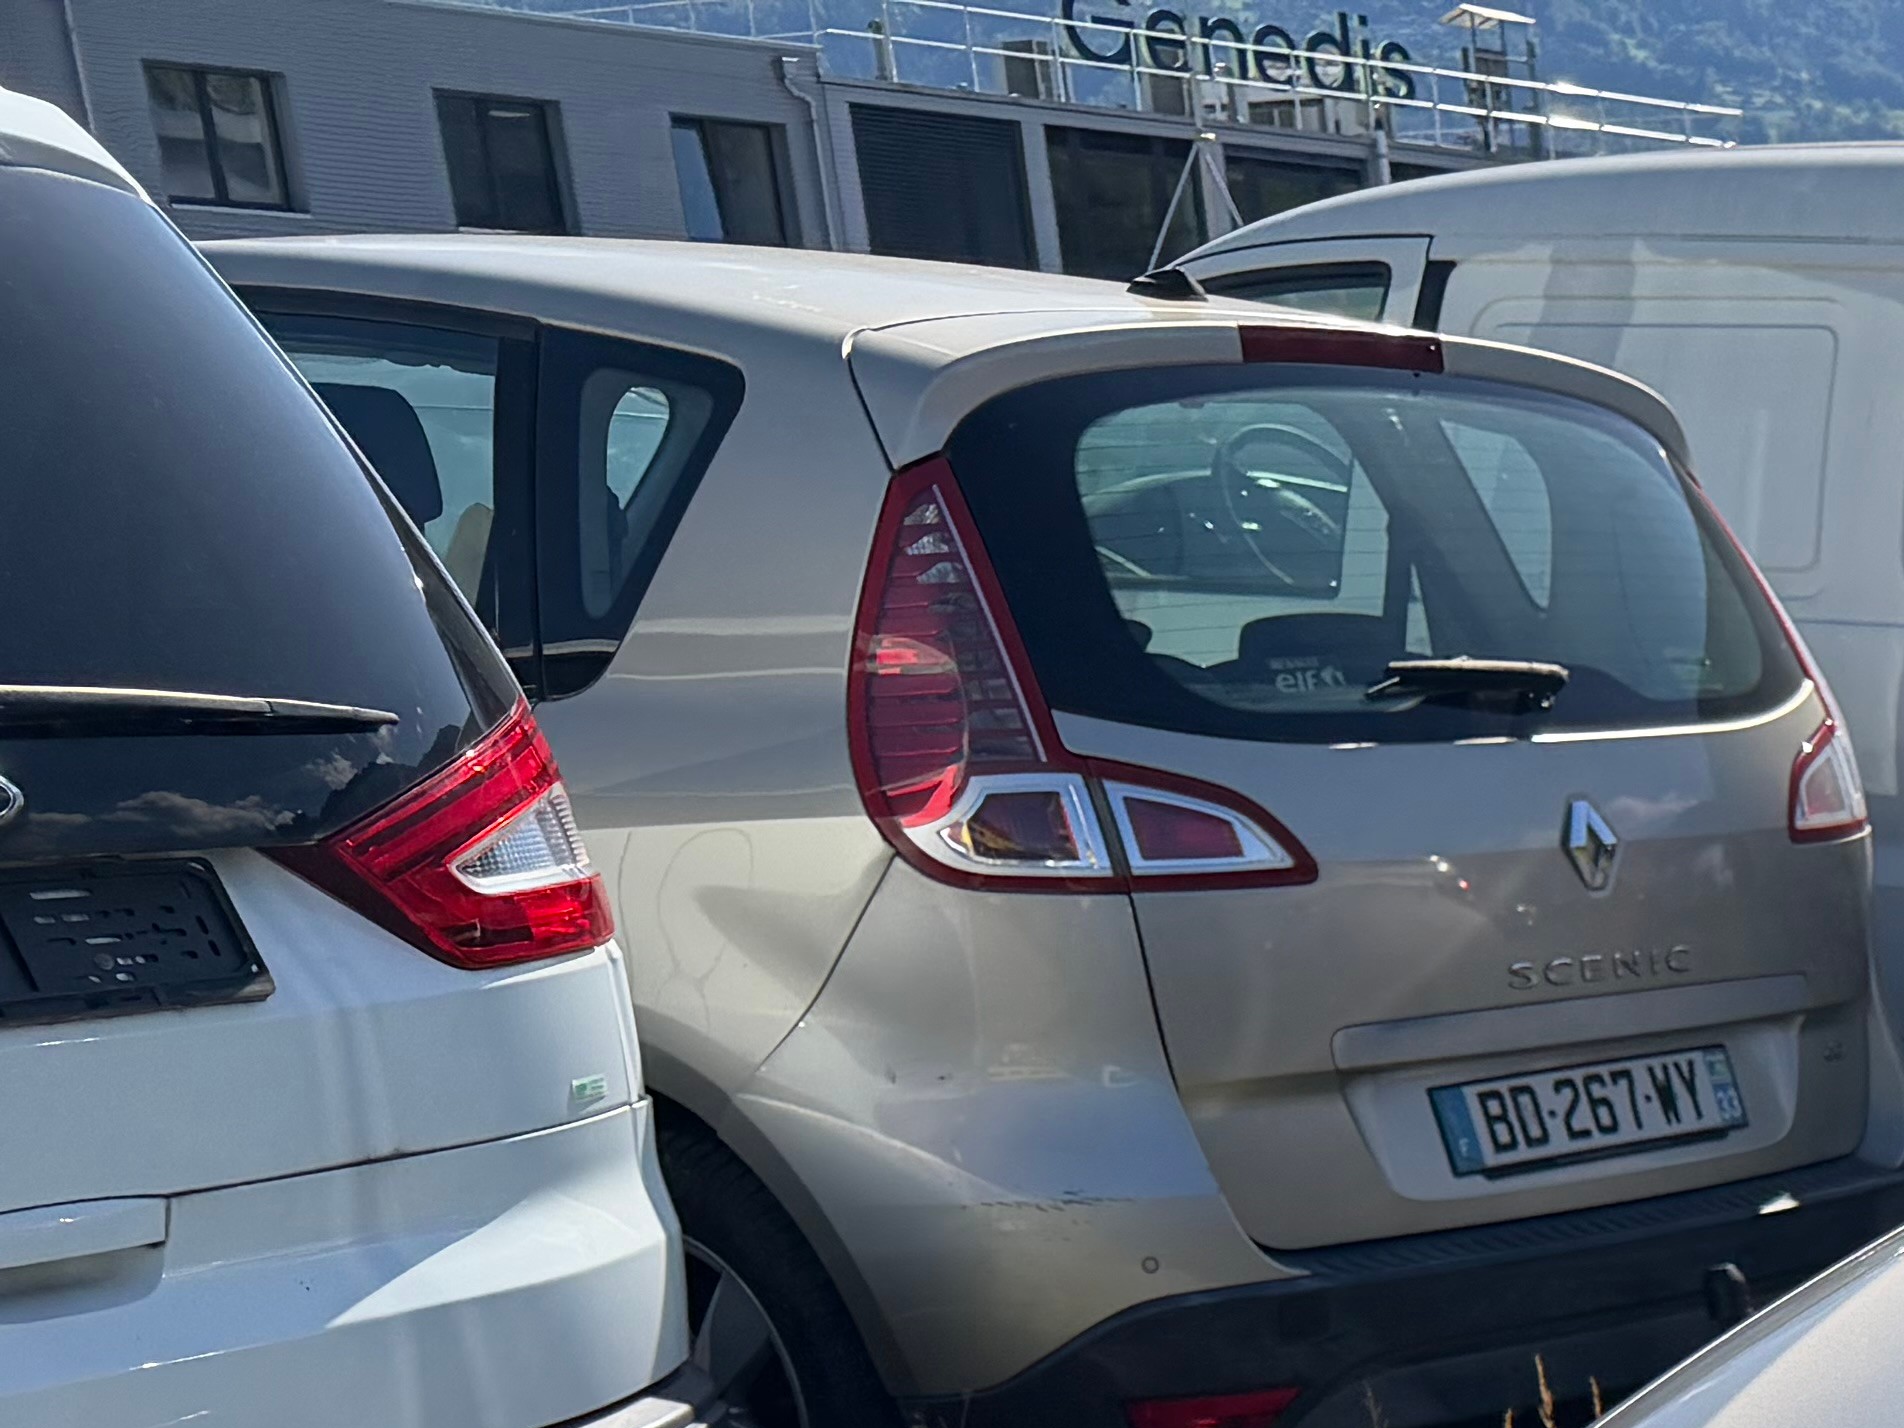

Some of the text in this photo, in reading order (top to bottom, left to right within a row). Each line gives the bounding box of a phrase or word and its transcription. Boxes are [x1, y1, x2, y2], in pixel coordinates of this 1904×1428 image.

[1061, 0, 1415, 100] Genedis
[1275, 670, 1318, 693] elf
[1507, 944, 1691, 990] SCENIC
